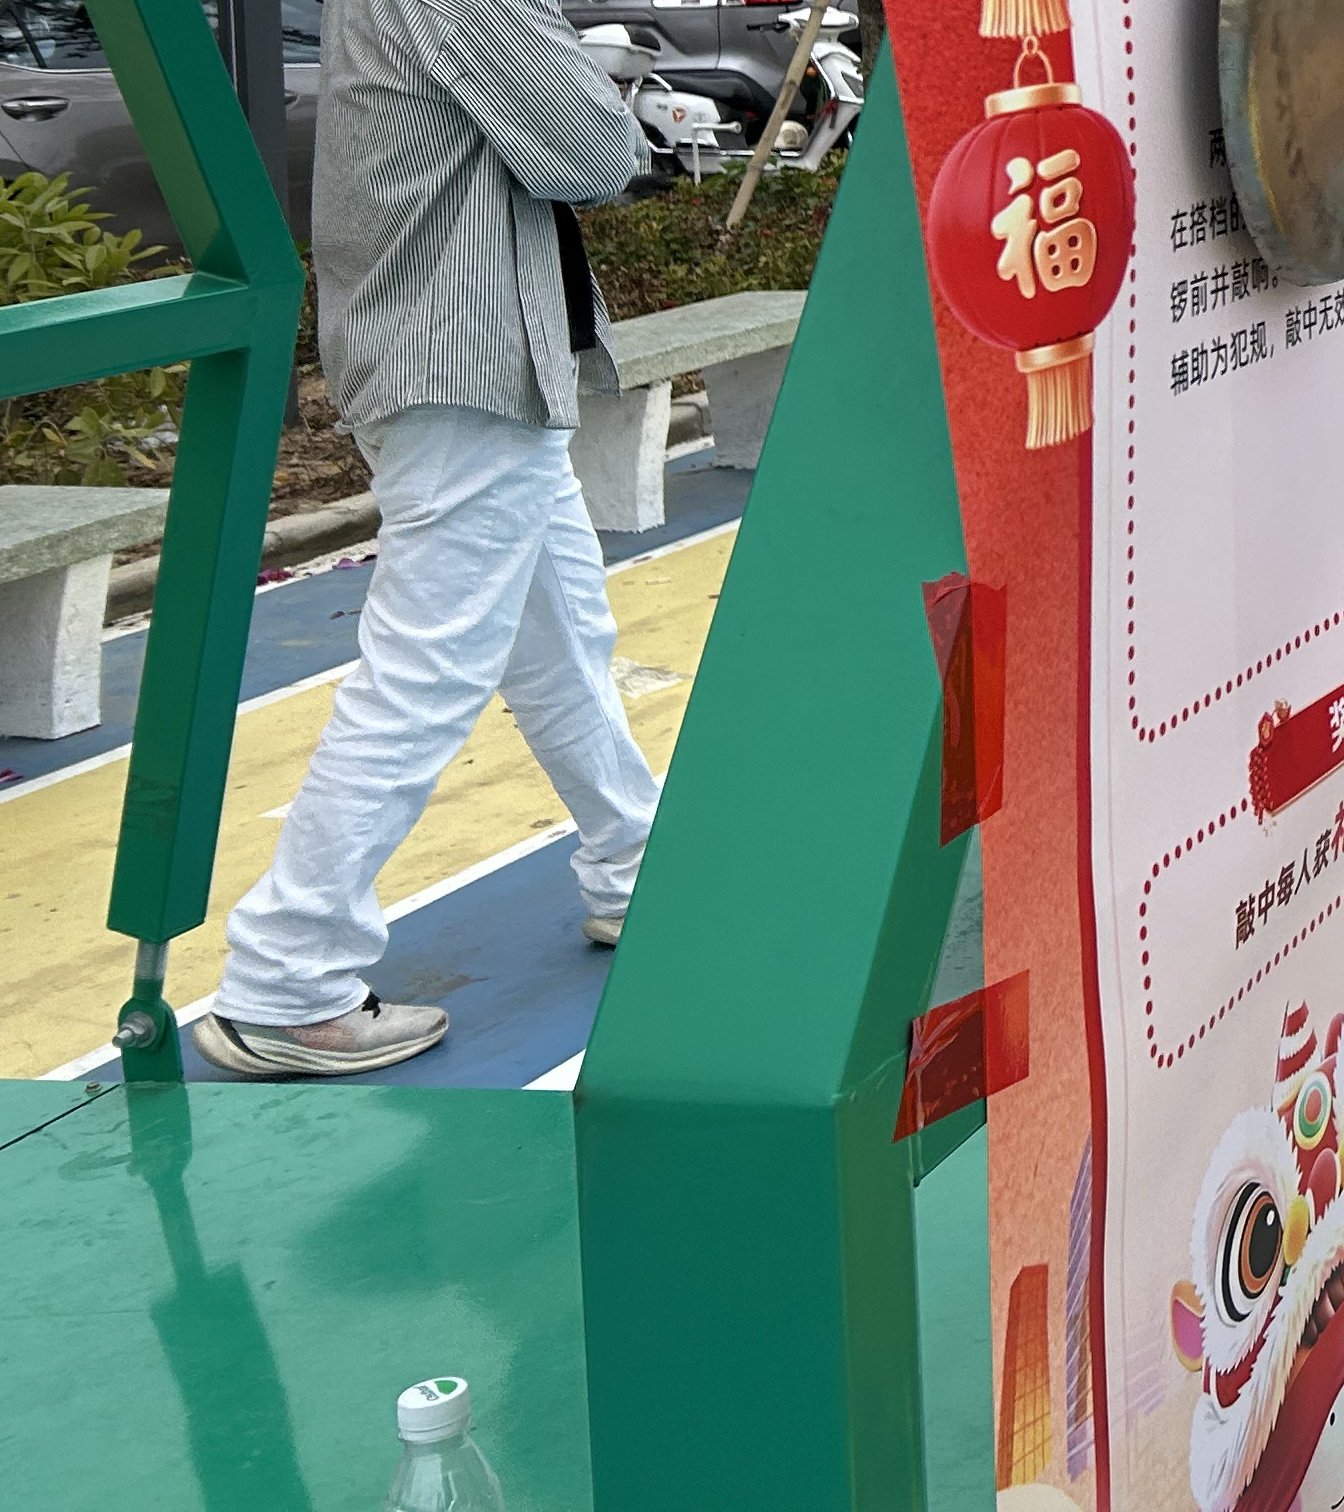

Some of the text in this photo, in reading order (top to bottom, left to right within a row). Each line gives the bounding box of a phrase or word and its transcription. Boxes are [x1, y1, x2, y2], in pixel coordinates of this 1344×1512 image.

[989, 147, 1098, 299] 福
[1170, 255, 1279, 324] 锣前并敲响。
